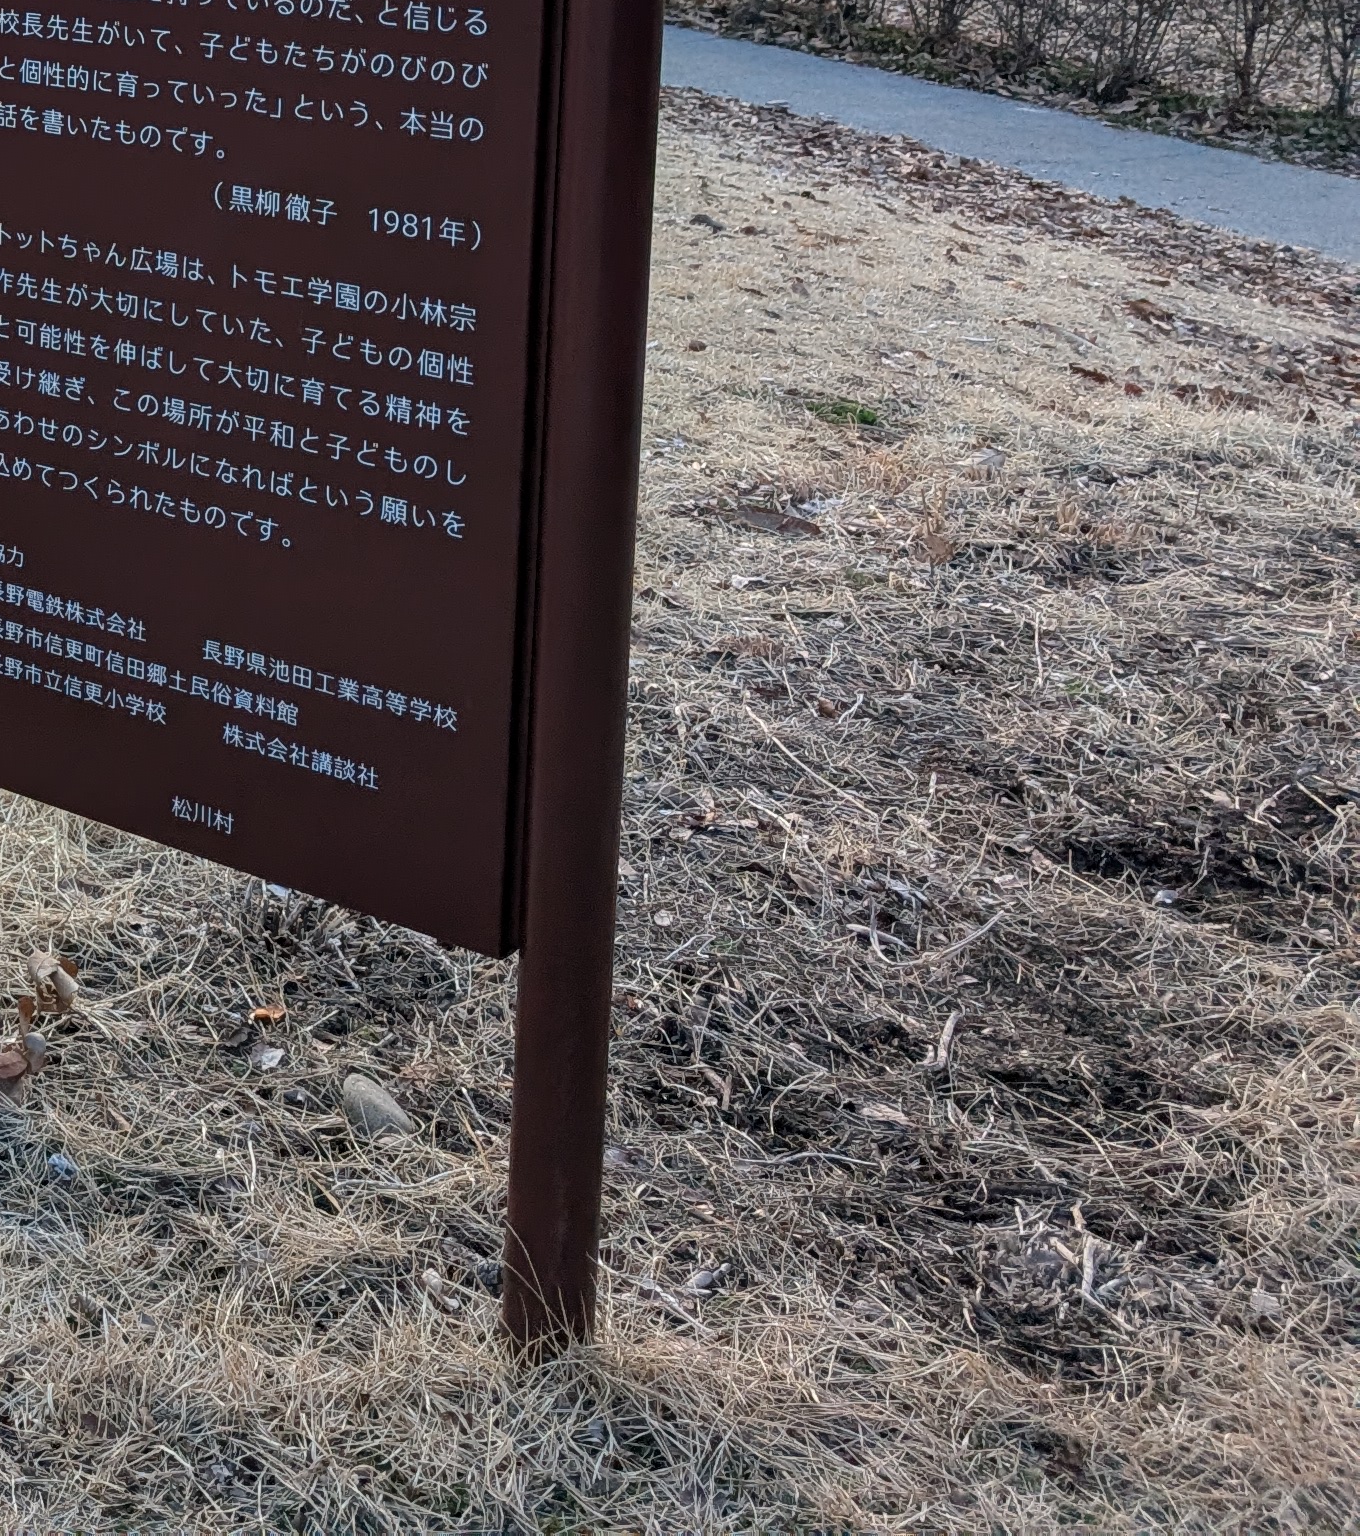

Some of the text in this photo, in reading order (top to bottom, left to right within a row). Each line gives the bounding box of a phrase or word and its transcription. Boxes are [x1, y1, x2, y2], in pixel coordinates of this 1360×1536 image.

[213, 180, 481, 251] （黒柳徹子 1981年）
[201, 639, 458, 732] 長野県池田工業高等学校
[222, 721, 379, 790] 株式会社講談社
[171, 795, 235, 835] 松川村
